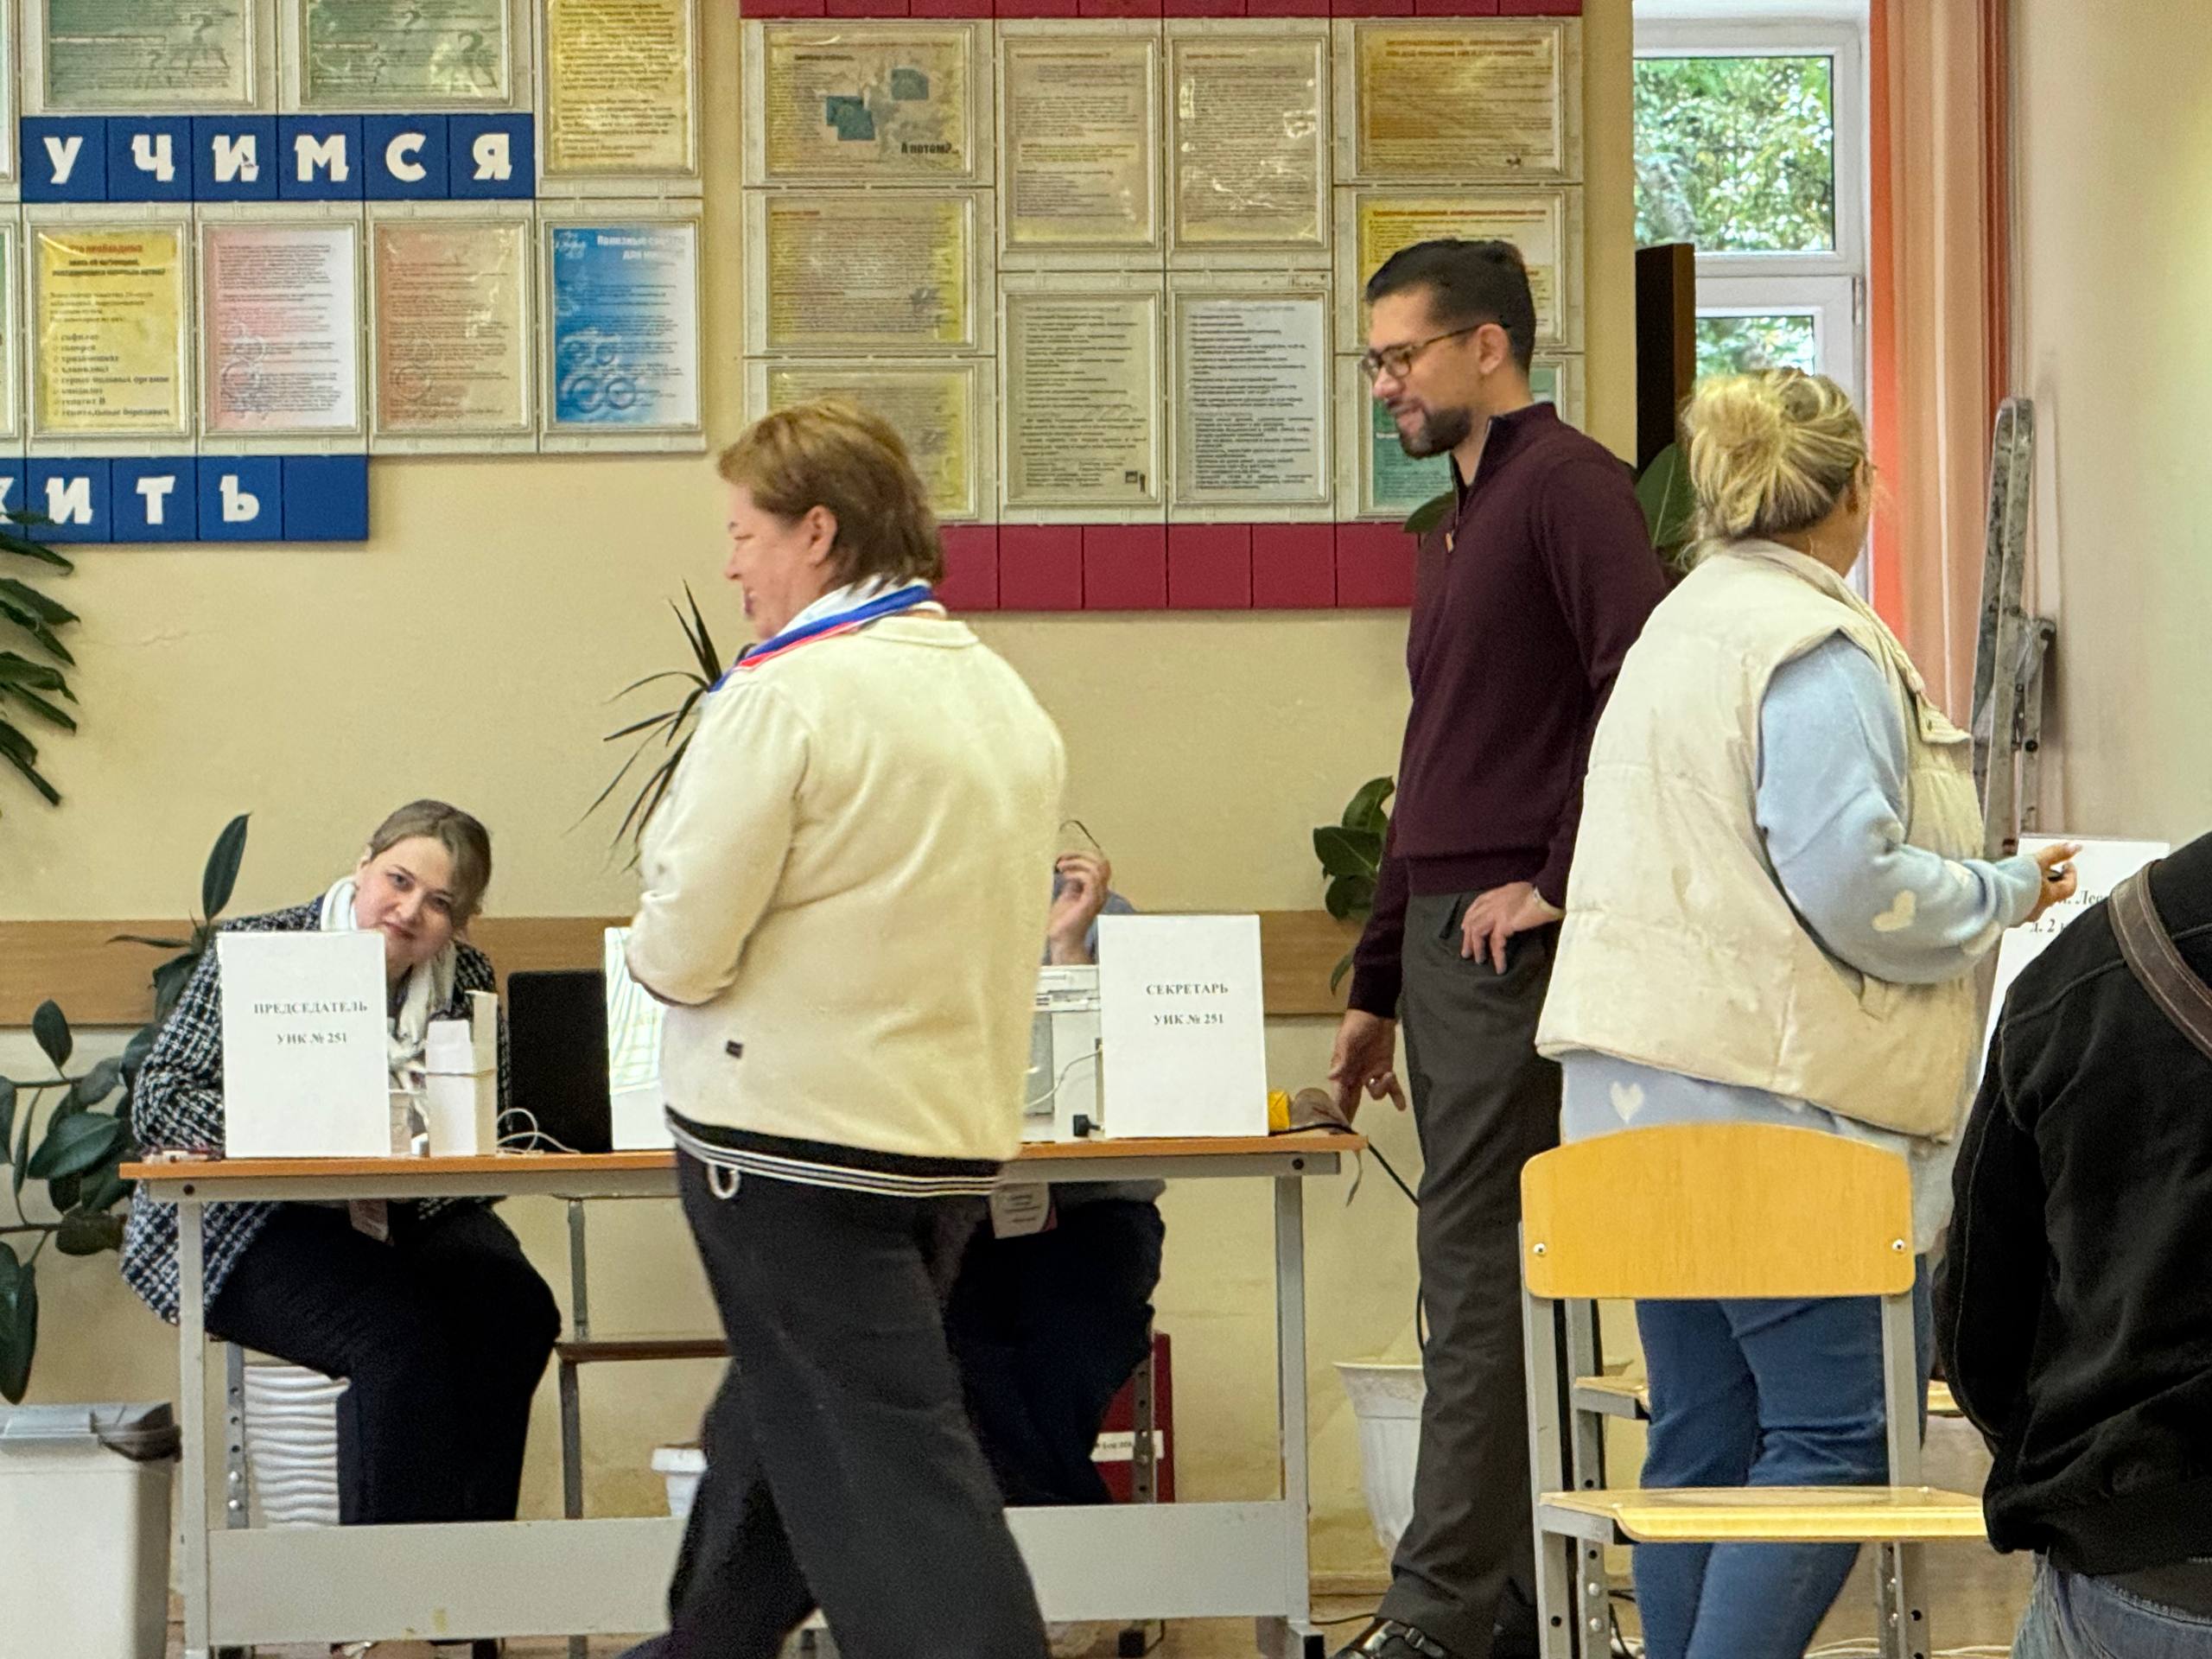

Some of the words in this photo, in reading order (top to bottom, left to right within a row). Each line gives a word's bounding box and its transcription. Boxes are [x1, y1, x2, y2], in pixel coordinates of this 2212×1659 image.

[43, 133, 513, 184] УЧИМСЯ
[2047, 918, 2056, 932] 2
[1146, 983, 1229, 995] СЕКРЕТАРЬ
[254, 1001, 368, 1014] ПРЕДСЕДАТЕЛЬ
[1154, 1014, 1184, 1025] УИК
[1185, 1014, 1200, 1025] №
[1204, 1014, 1224, 1024] 251
[276, 1033, 307, 1044] УИК
[309, 1033, 324, 1044] №
[327, 1033, 346, 1043] 251
